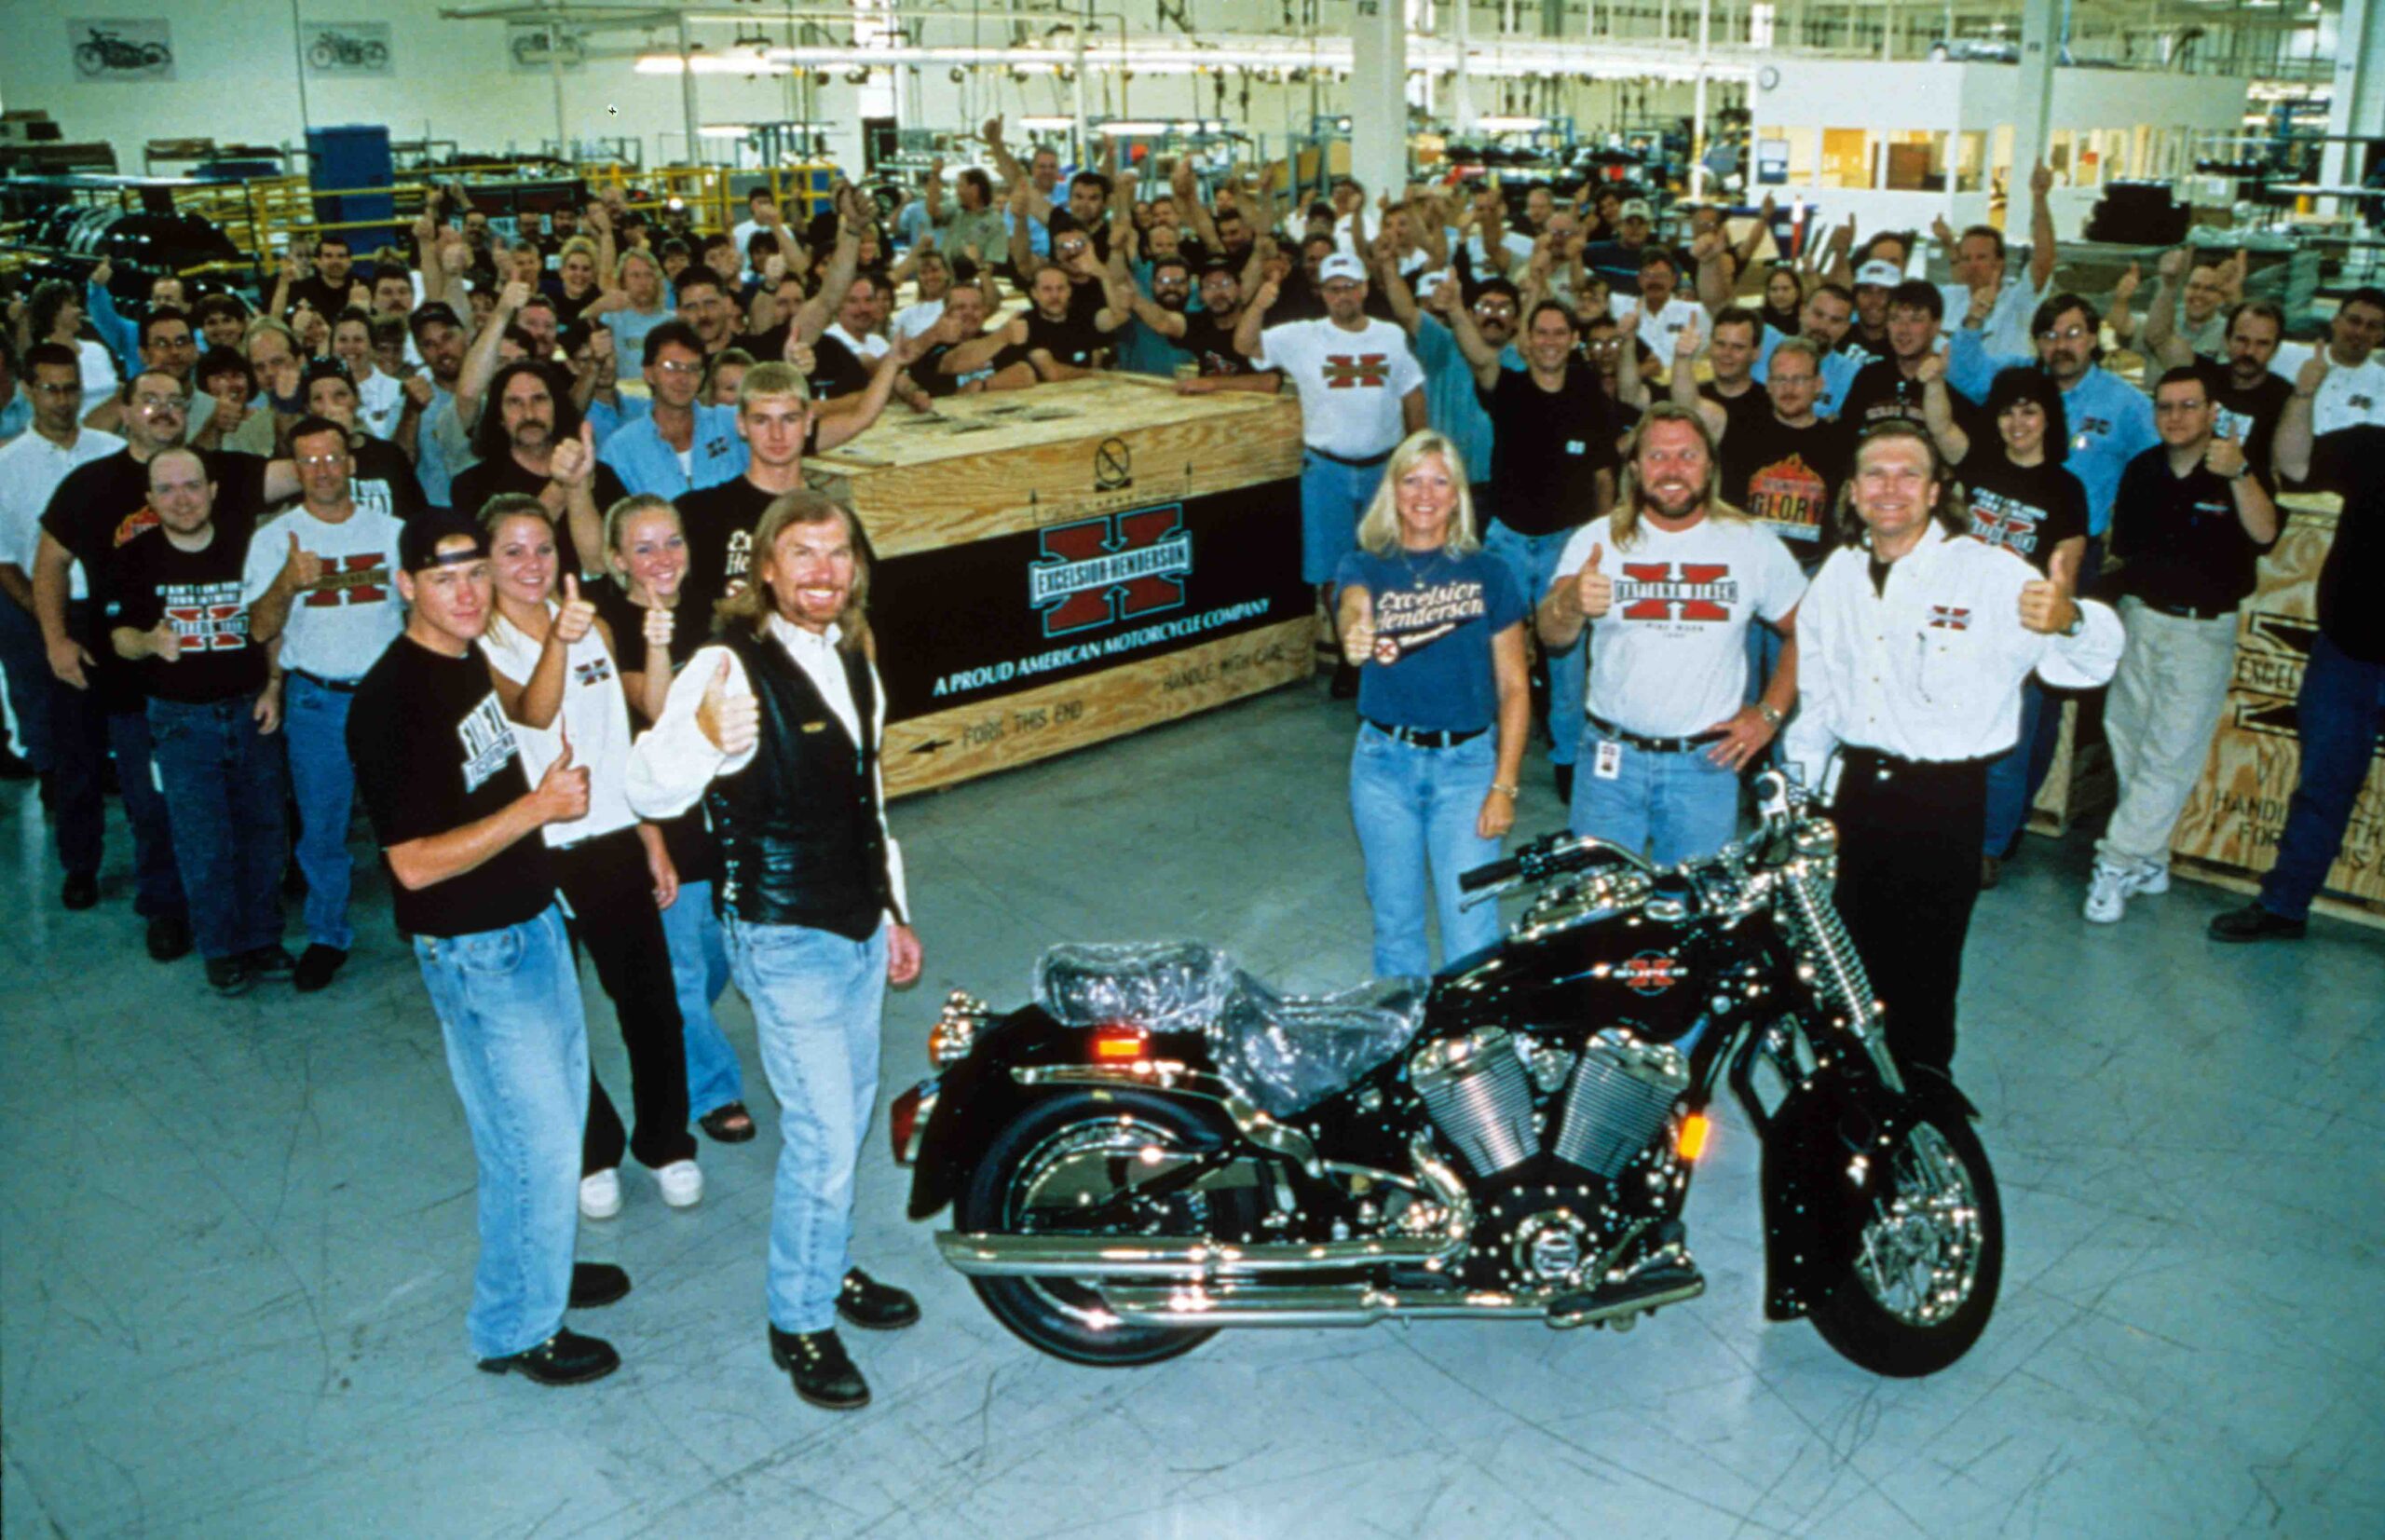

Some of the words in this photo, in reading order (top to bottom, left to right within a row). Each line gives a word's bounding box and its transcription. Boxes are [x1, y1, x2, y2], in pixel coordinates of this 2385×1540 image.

[1037, 540, 1185, 594] EXCELSIOR-HENDERSON
[1377, 580, 1483, 610] Excelsior
[1690, 581, 1738, 603] BEACH
[933, 676, 948, 697] A
[949, 661, 1015, 693] PROUD
[1016, 640, 1103, 676] AMERICAN
[1103, 614, 1202, 654] MOTORCYCLE
[1202, 597, 1271, 630] COMPANY
[961, 717, 1005, 749] FORK
[1015, 707, 1048, 733] THIS
[1053, 700, 1083, 725] END
